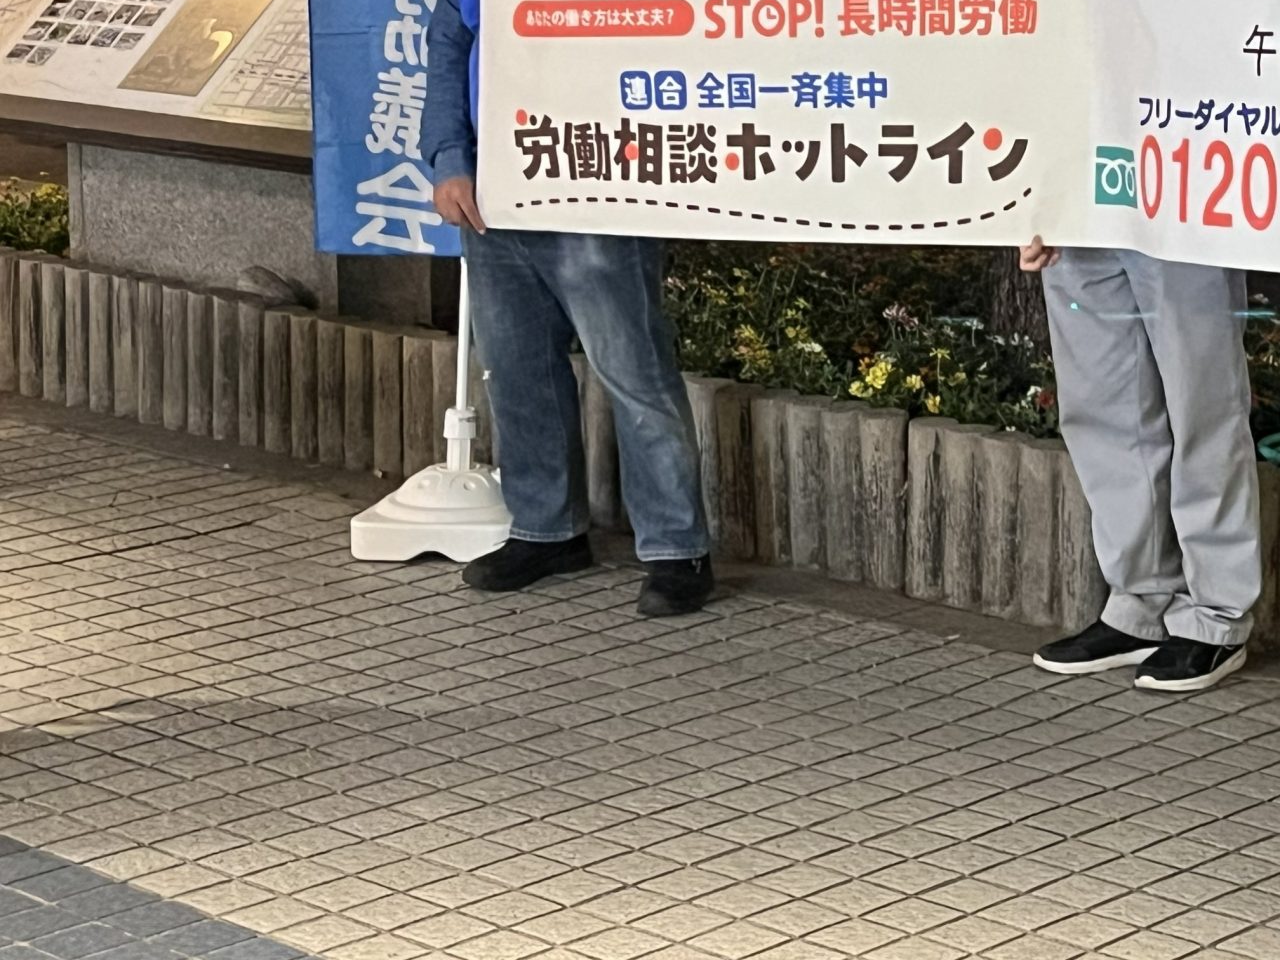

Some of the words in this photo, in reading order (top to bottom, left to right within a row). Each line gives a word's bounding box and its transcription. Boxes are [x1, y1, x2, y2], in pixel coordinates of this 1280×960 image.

[526, 8, 675, 27] あなたの働き方は大丈夫?
[624, 74, 684, 106] 連合
[696, 71, 889, 110] 全国一斉集中
[513, 109, 1031, 187] 労働相談ホットライン
